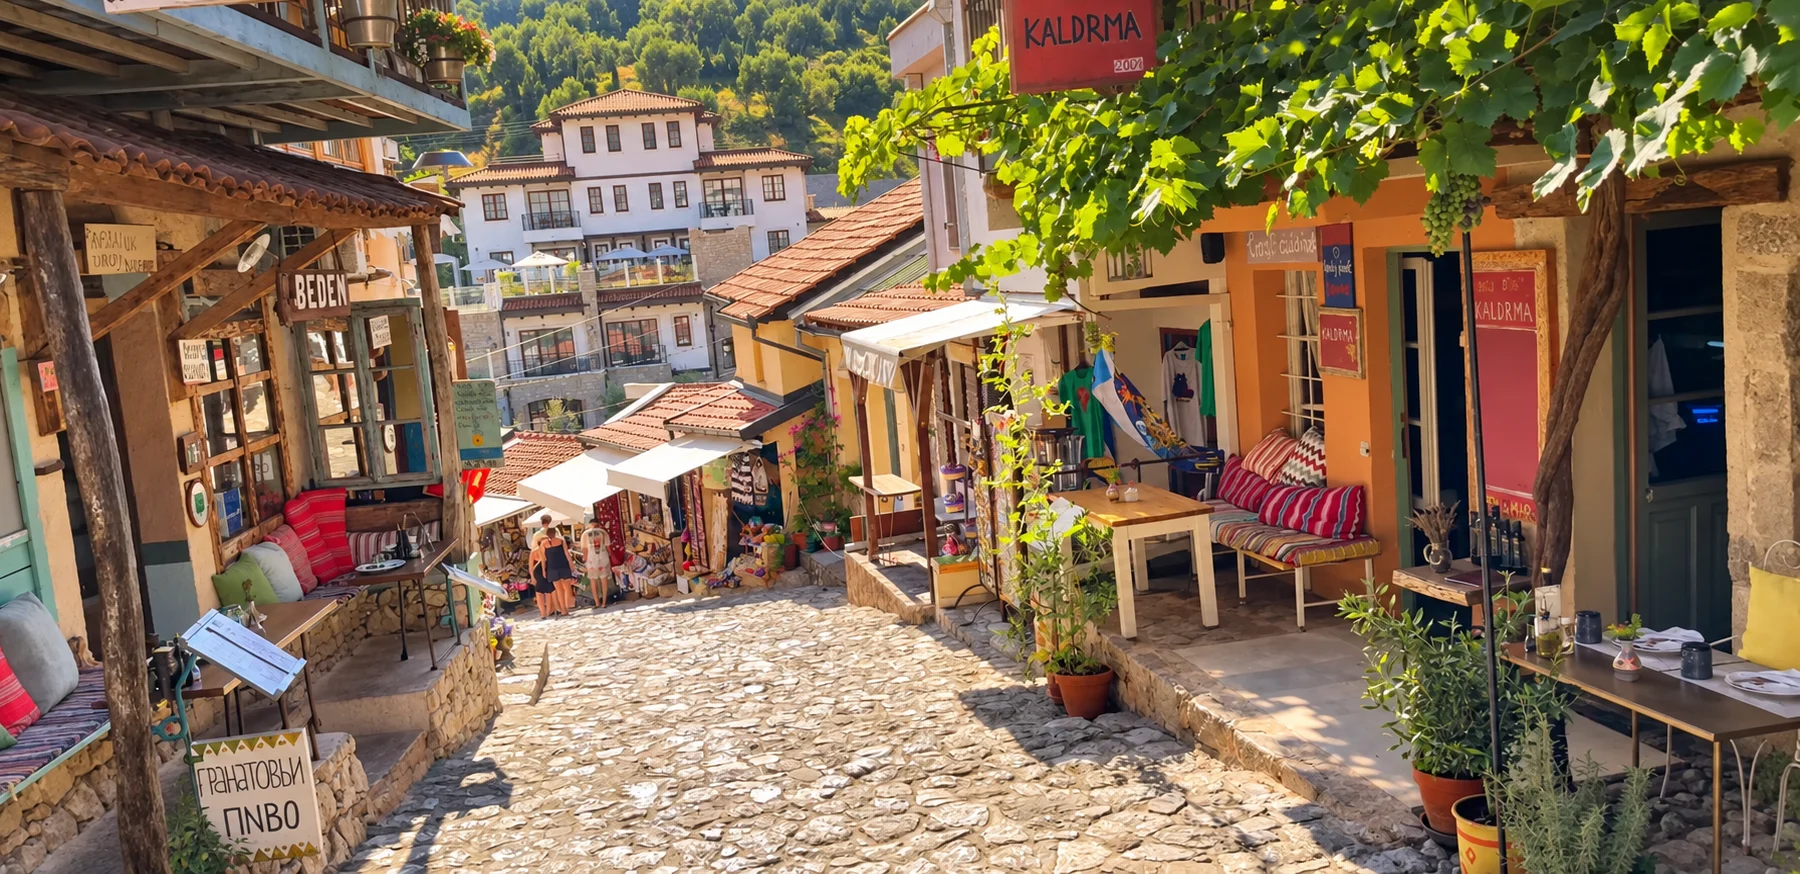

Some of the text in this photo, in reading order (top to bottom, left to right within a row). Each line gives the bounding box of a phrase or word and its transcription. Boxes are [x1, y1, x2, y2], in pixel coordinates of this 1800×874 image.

[1024, 10, 1142, 49] KALDRMA
[294, 273, 347, 310] BEDEN
[1474, 300, 1534, 323] KALDRMA
[1321, 327, 1354, 342] KALDRMA
